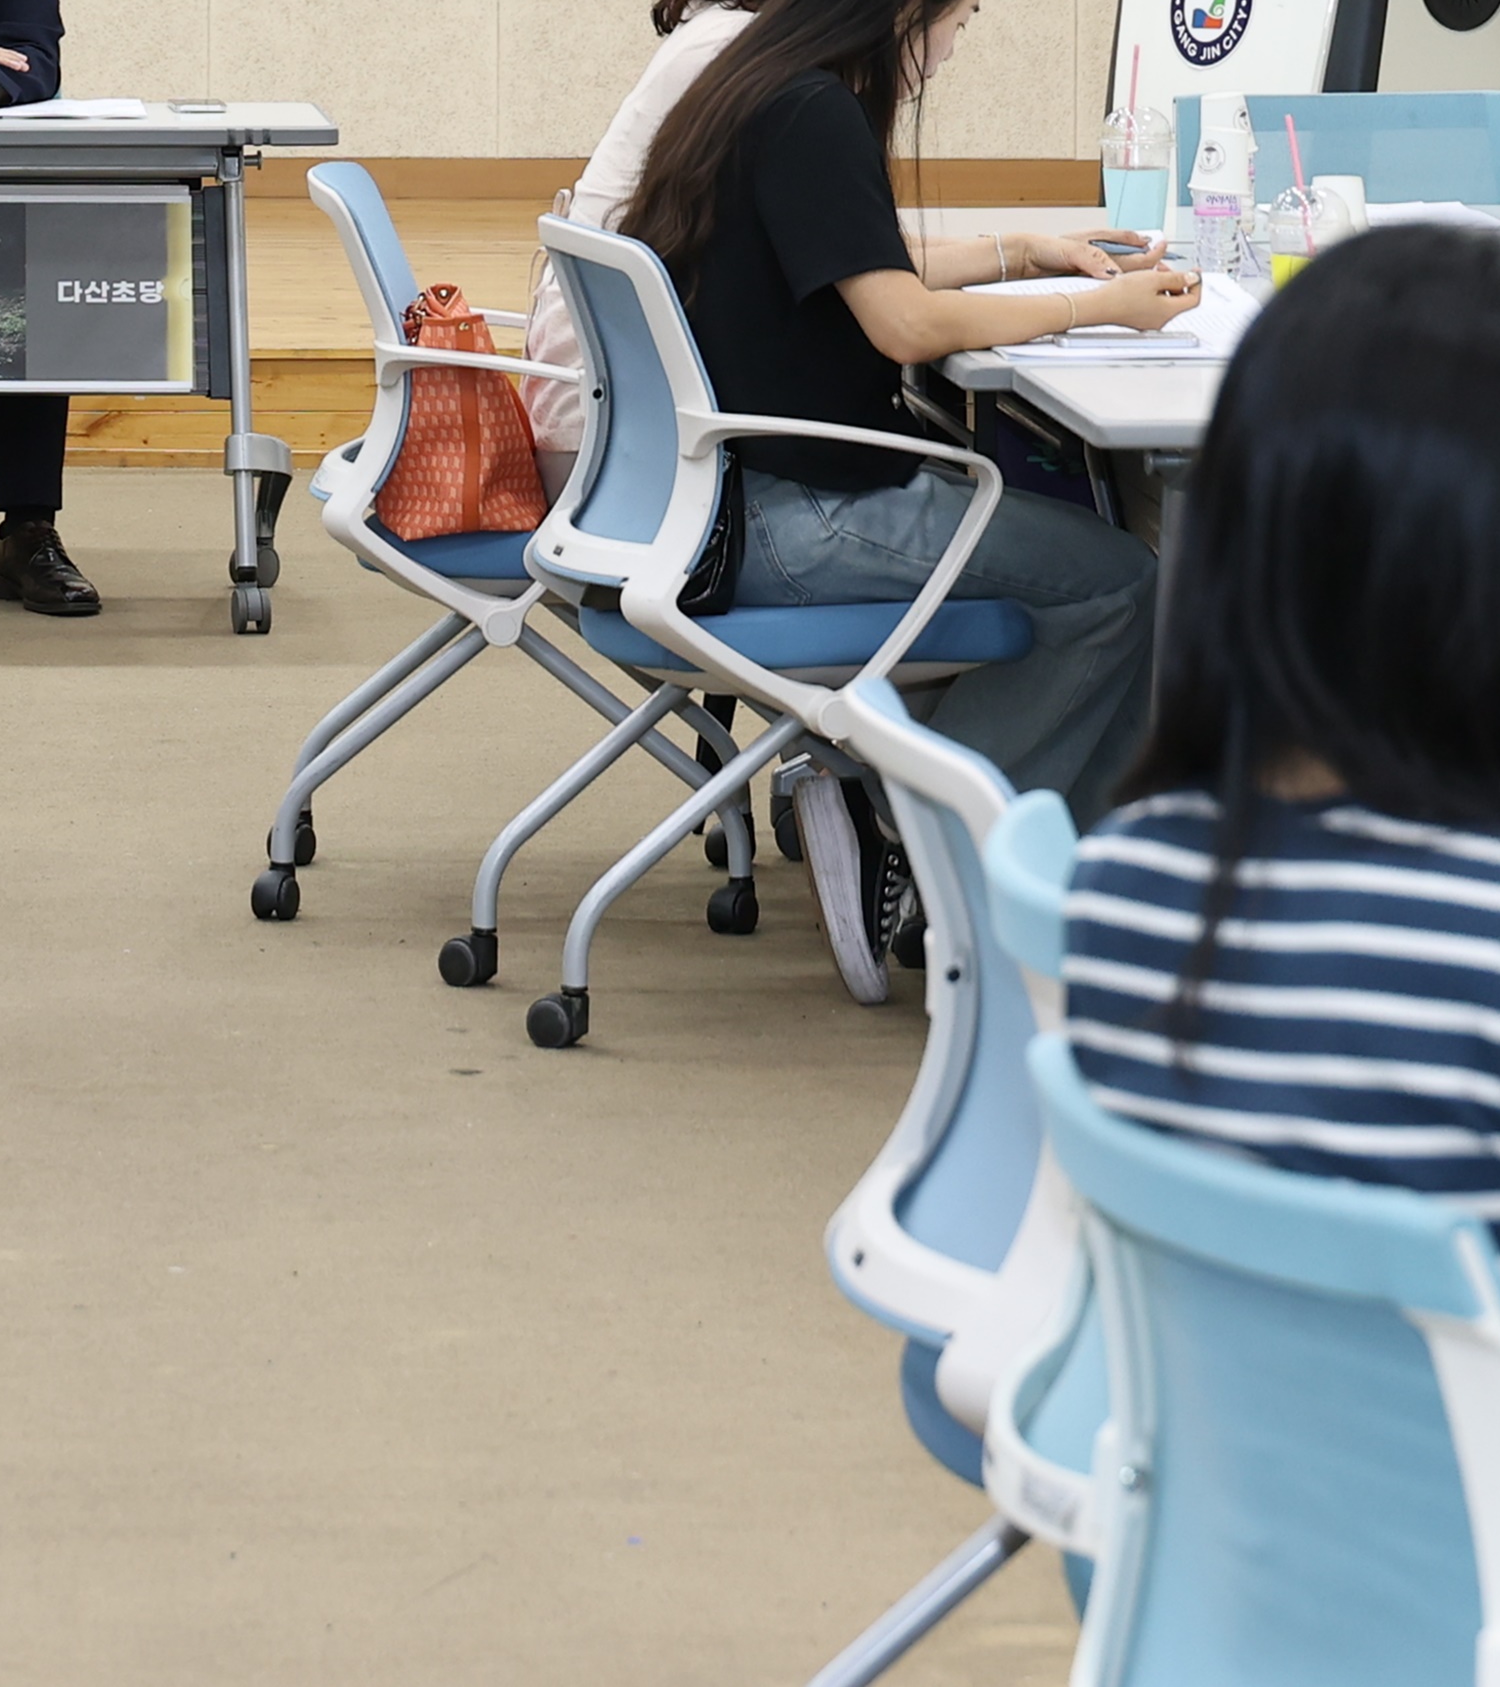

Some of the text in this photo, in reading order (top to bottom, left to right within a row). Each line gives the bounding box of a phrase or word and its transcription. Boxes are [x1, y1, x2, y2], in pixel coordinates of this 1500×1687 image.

[1173, 8, 1249, 61] GANG JIN CITY
[57, 280, 165, 304] 다산초당
